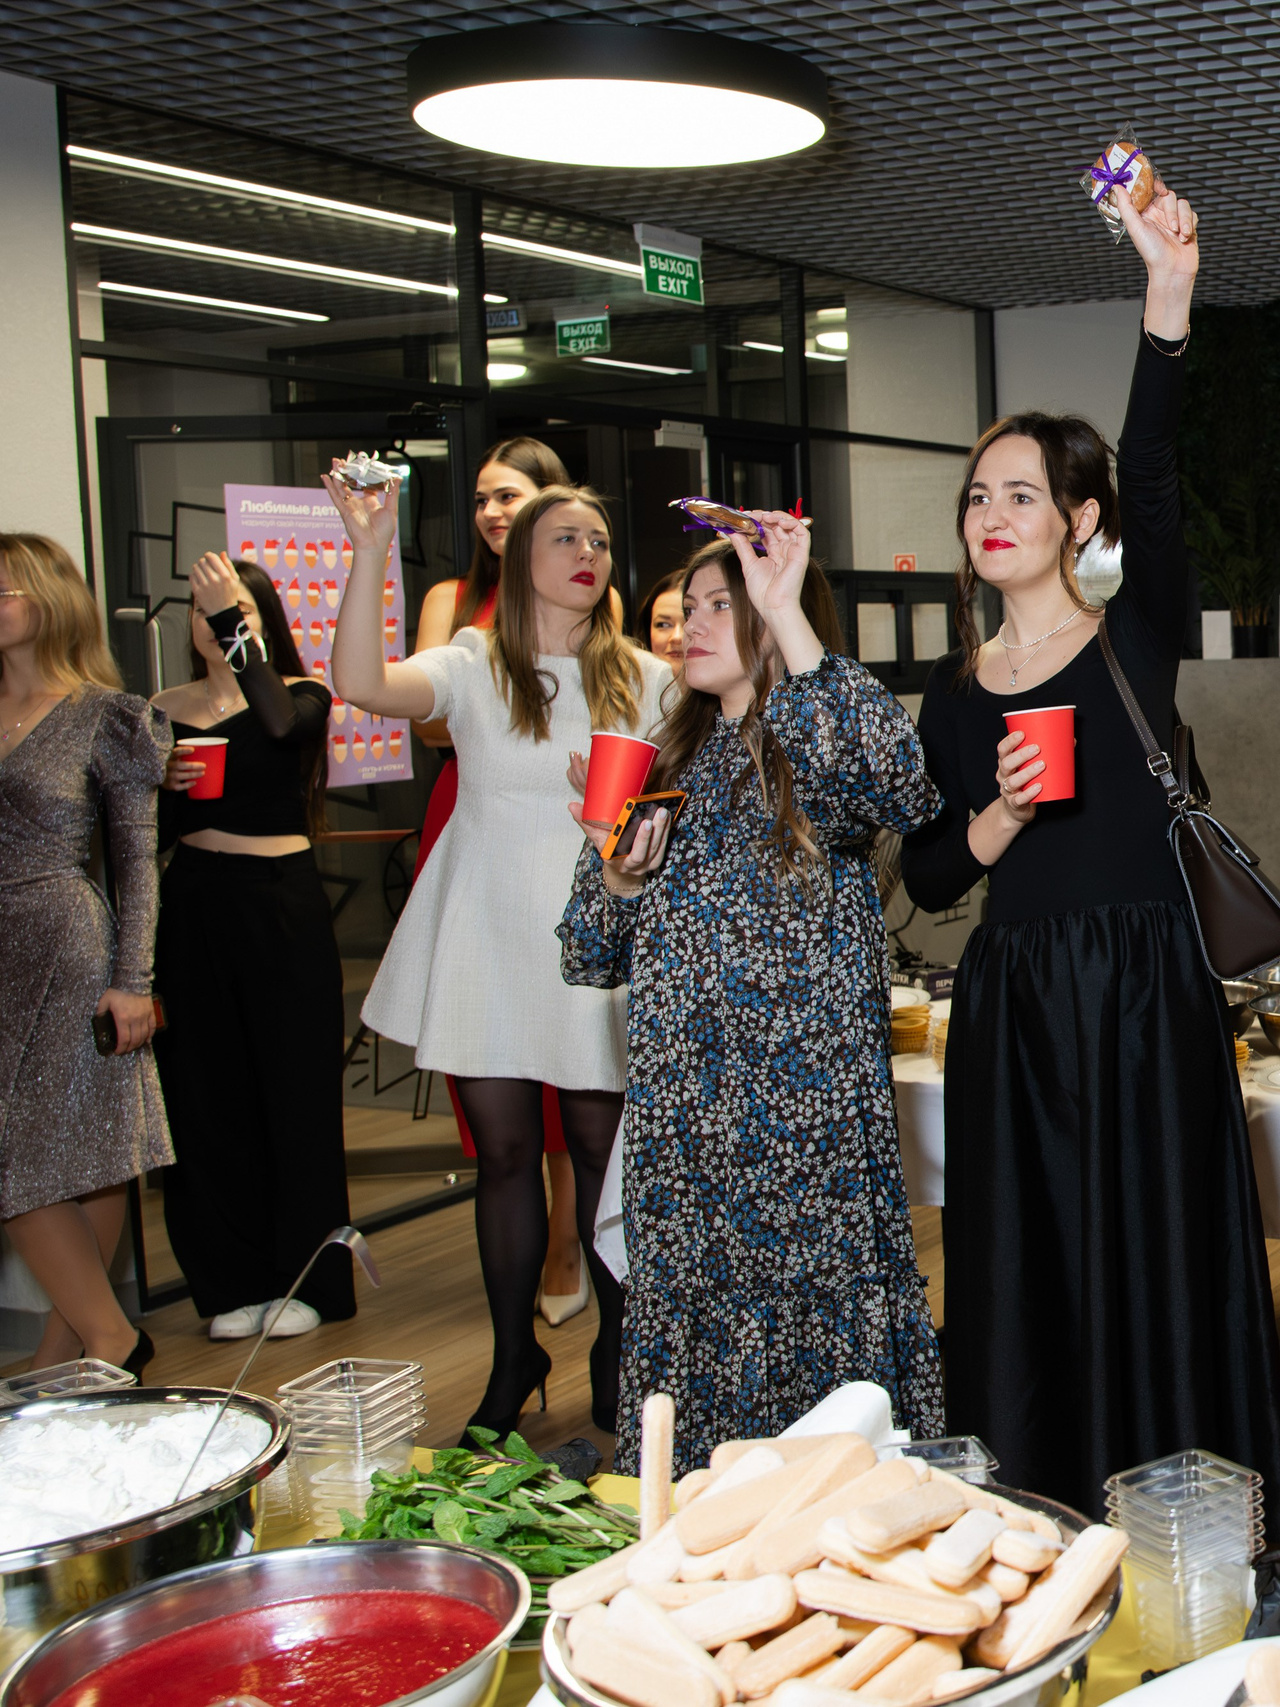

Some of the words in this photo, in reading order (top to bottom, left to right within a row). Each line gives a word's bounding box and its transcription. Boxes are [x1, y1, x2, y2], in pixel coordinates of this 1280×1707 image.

[648, 254, 695, 280] ВЫХОД
[658, 275, 689, 296] EXIT
[486, 309, 519, 327] ХОД
[562, 322, 603, 338] ВЫХОД
[569, 336, 597, 353] EXIT
[240, 500, 311, 515] Любимые
